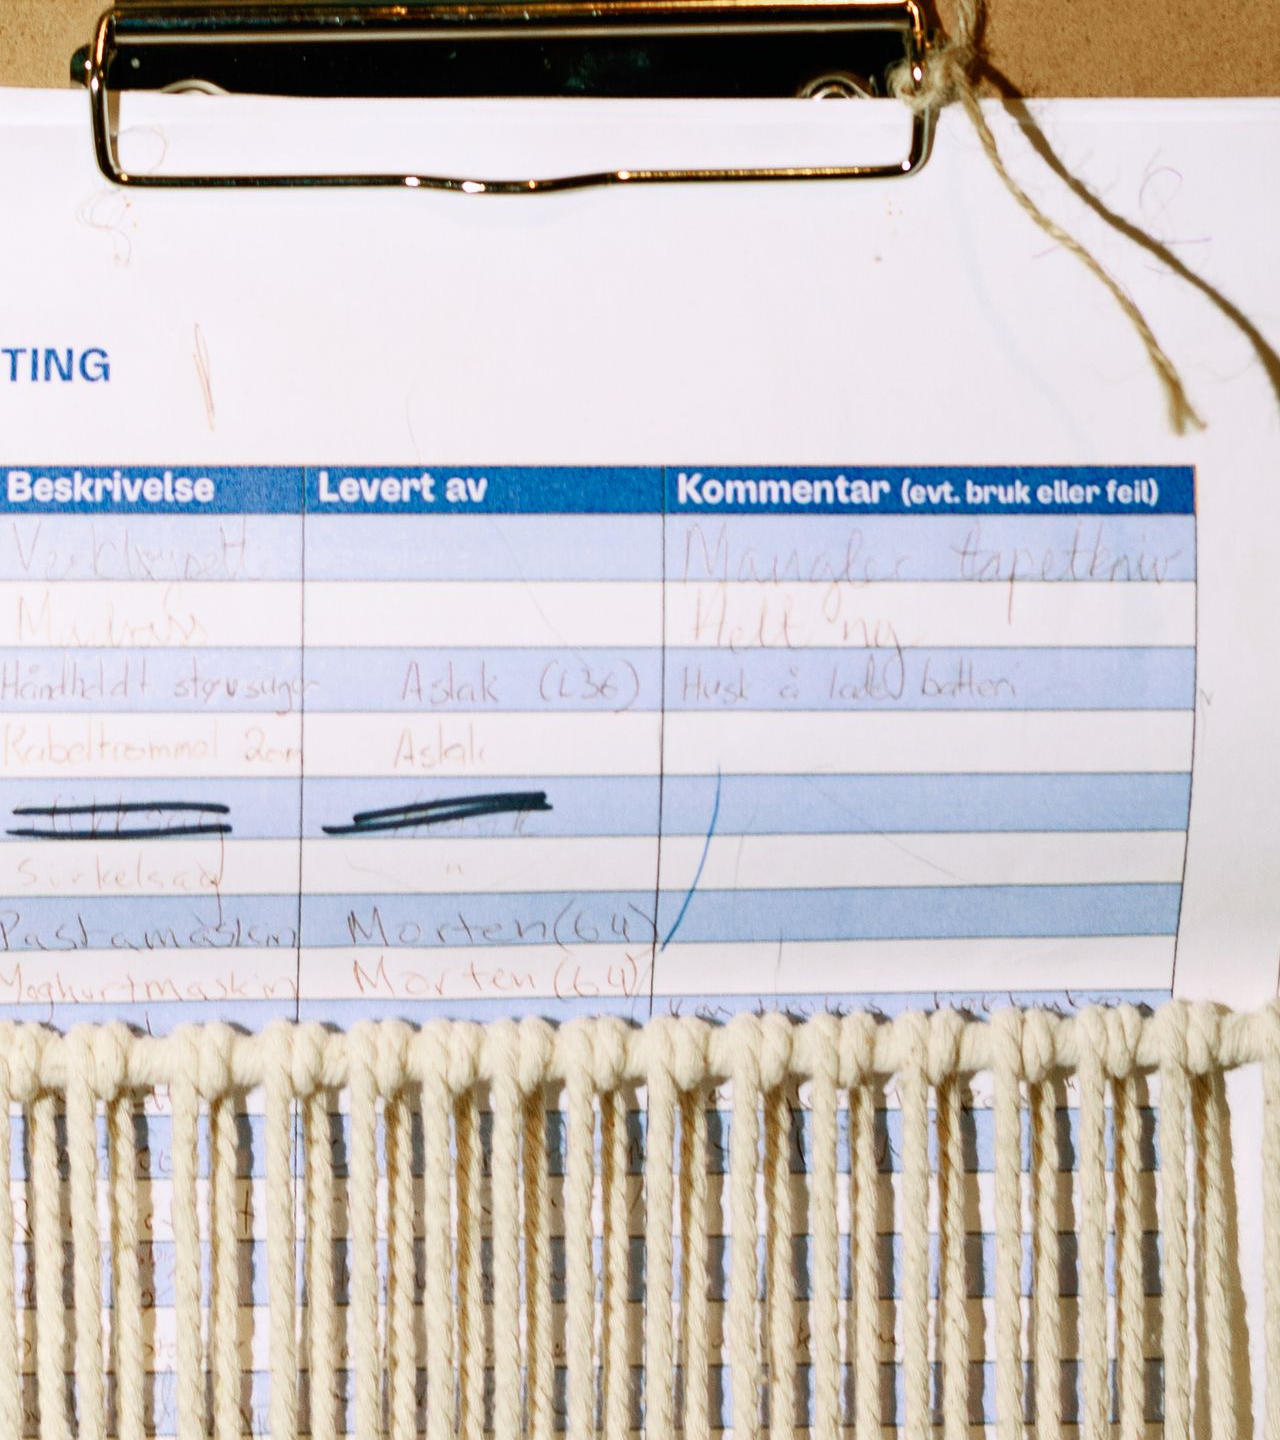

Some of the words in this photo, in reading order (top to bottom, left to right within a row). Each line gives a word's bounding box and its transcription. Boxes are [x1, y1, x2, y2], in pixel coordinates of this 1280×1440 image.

[6, 470, 216, 503] Beskrivelse
[318, 470, 436, 503] Levert
[445, 476, 488, 503] av
[676, 472, 892, 506] Kommentar
[901, 478, 961, 508] (evt.
[966, 480, 1031, 505] bruk
[1036, 480, 1100, 504] eller
[1105, 479, 1160, 507] feil)
